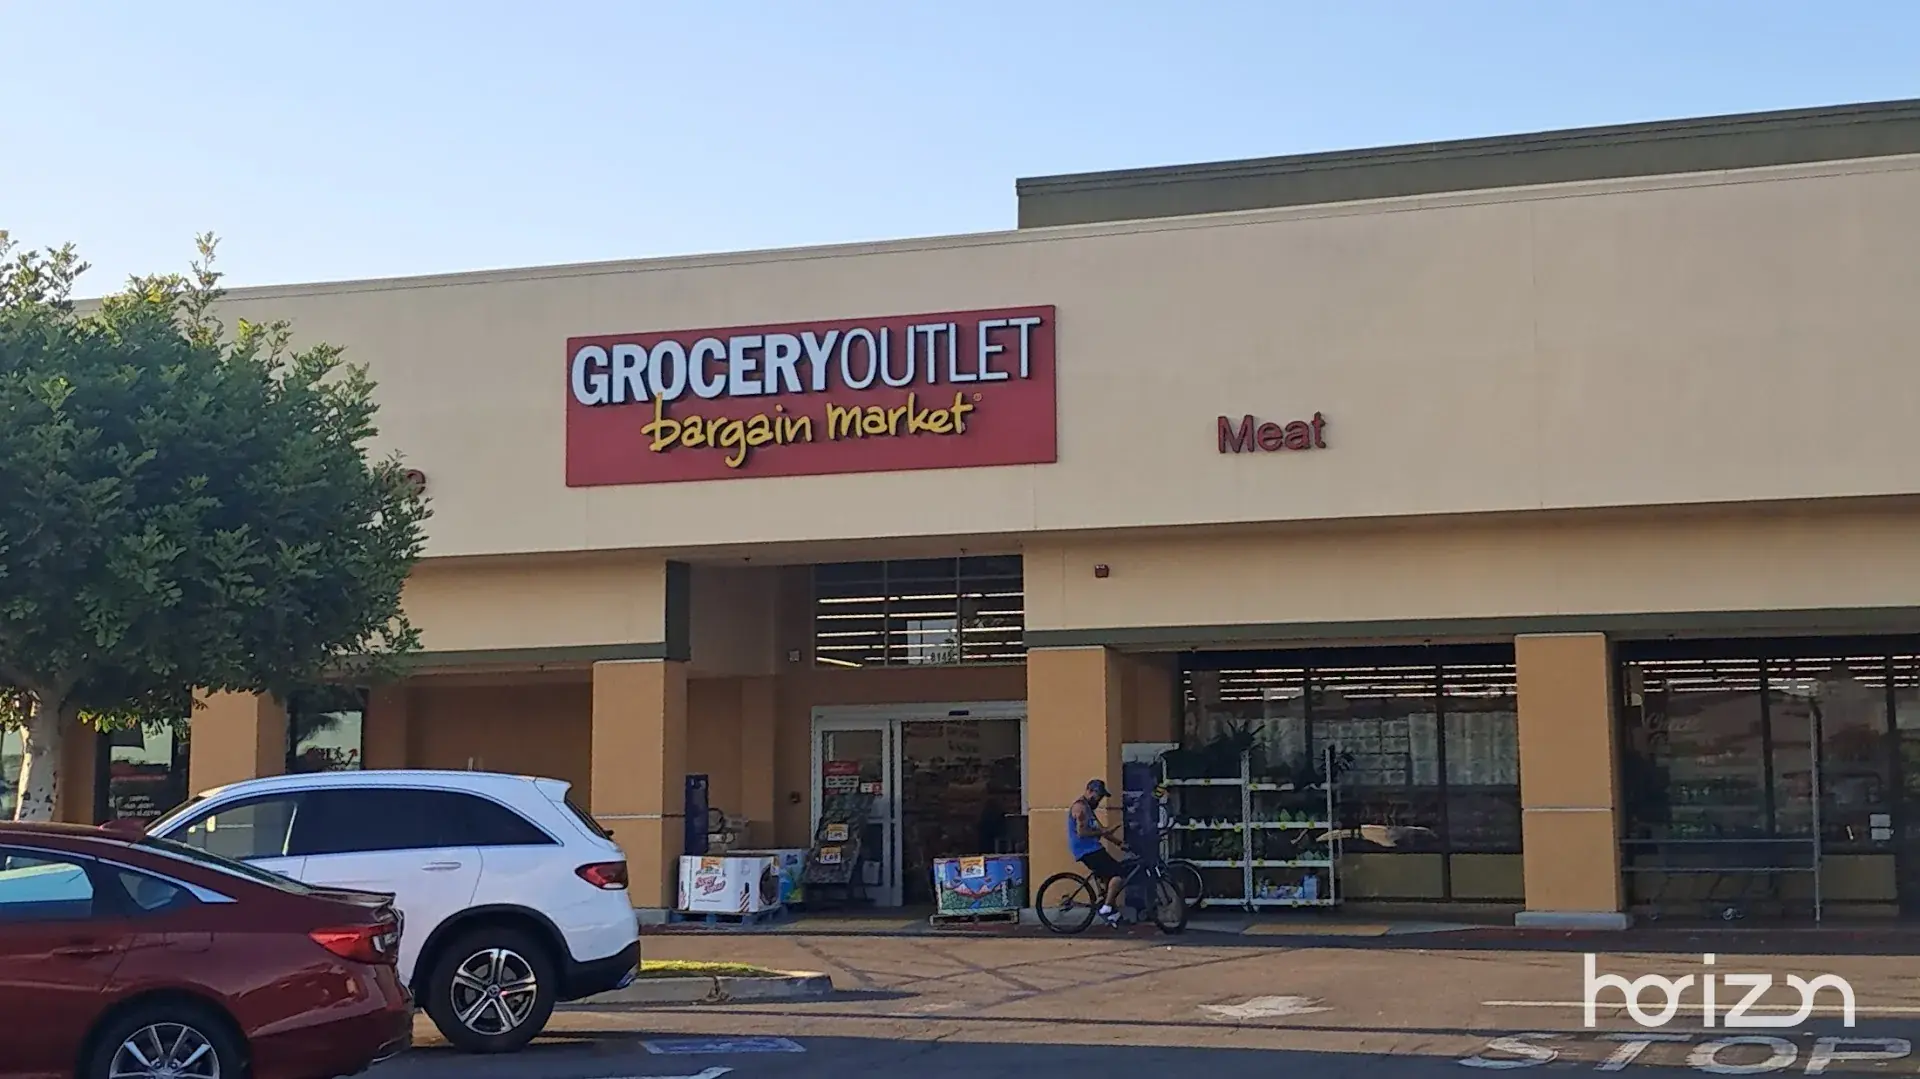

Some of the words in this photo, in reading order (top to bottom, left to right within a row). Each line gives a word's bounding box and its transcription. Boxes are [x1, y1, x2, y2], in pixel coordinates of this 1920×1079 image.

[641, 392, 812, 468] bargain
[826, 391, 974, 441] market
[1217, 411, 1327, 454] Meat
[1458, 1032, 1912, 1076] STOP
